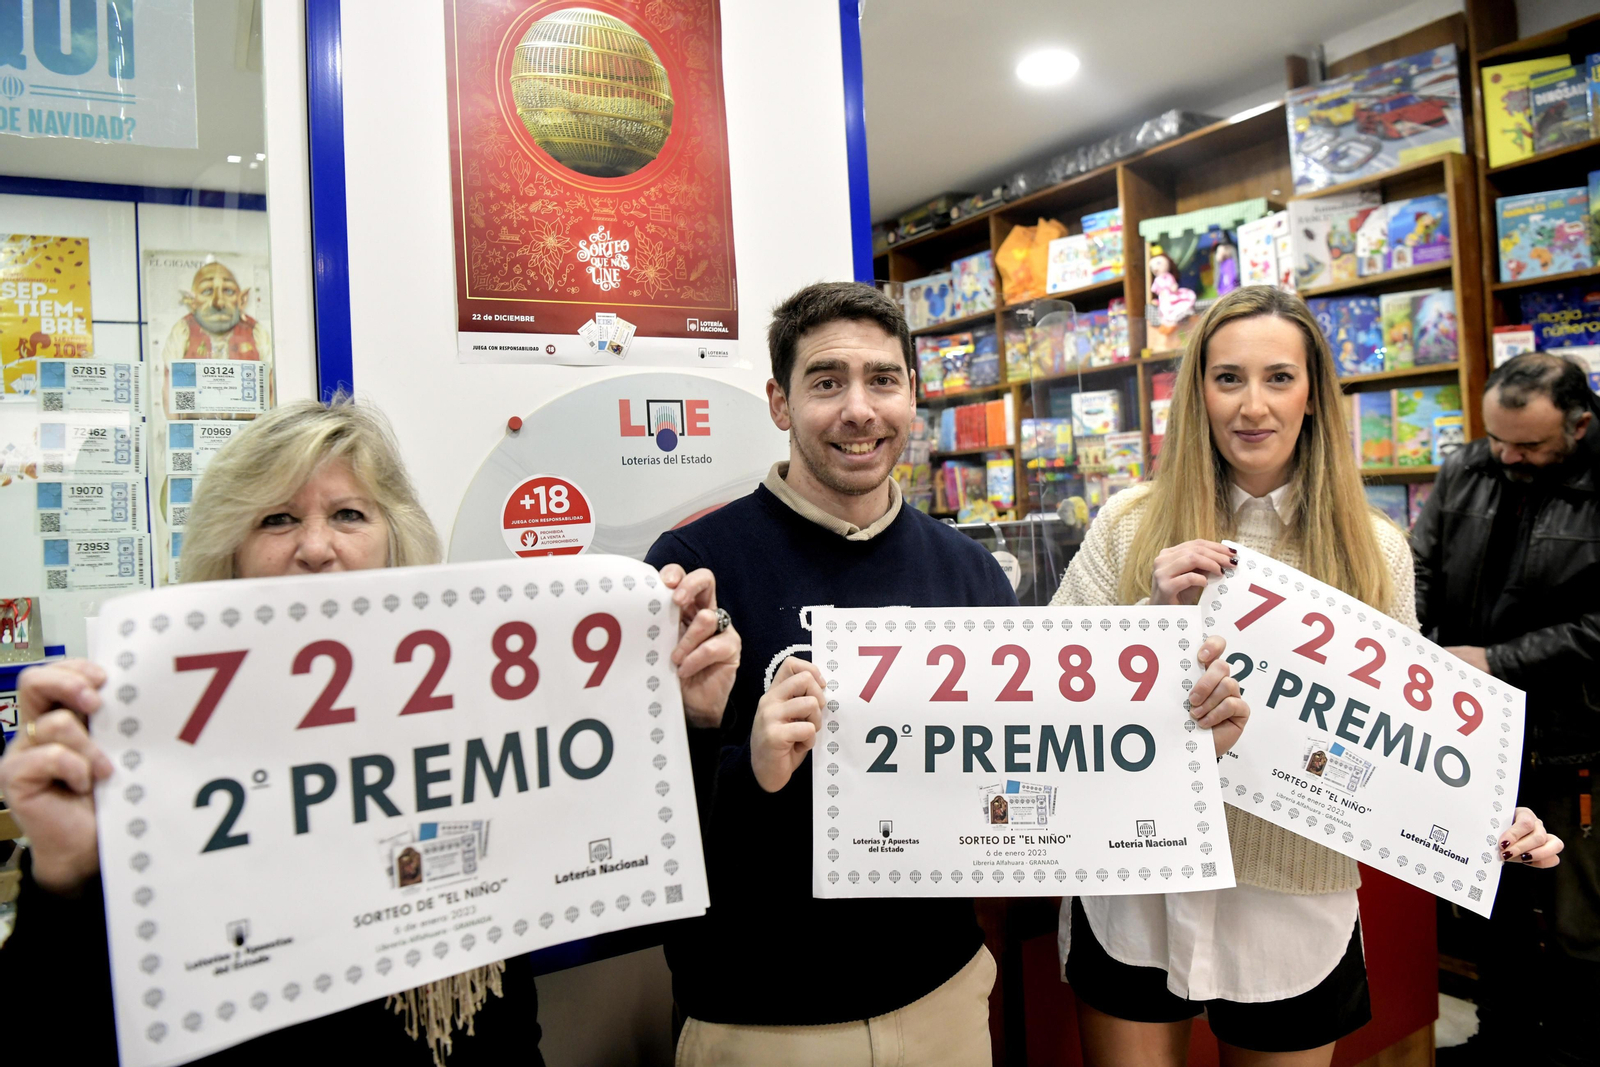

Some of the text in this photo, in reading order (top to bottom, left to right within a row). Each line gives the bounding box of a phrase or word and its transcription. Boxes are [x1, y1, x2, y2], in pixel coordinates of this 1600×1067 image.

[28, 108, 136, 141] NAVIDAD?
[588, 225, 613, 242] EL
[577, 239, 630, 262] SORTEO
[163, 258, 203, 270] GIGANT
[590, 253, 630, 270] QUE NOS
[585, 266, 621, 291] UNE
[1, 282, 59, 299] SEP-
[14, 300, 84, 317] TIEM-
[41, 317, 87, 335] BRE
[494, 314, 535, 322] DICIEMBRE
[72, 366, 106, 375] 67815
[203, 366, 235, 375] 03124
[73, 427, 107, 437] 72462
[200, 427, 232, 436] 70969
[621, 453, 713, 466] Loterías del Estado
[70, 486, 104, 495] 19070
[520, 484, 570, 515] +18
[540, 515, 584, 523] RESPONSABILIDAD
[76, 542, 110, 551] 73953
[541, 538, 579, 546] AUTOPROHIBIDOS
[1266, 668, 1471, 788] PREMIO
[924, 723, 1157, 773] PREMIO
[290, 717, 614, 835] PREMIO
[1271, 768, 1372, 814] SORTEO DE "EL NIÑO"
[1297, 792, 1306, 800] de
[1307, 797, 1326, 808] enero
[1327, 804, 1346, 816] 2023
[1325, 813, 1352, 828] GRANADA
[852, 837, 881, 845] Loterías
[888, 838, 920, 846] Apuestas
[959, 833, 1072, 845] SORTEO DE "EL NIÑO"
[1108, 837, 1188, 848] Lotería Nacional
[1400, 829, 1469, 865] Lotería Nacional
[993, 849, 1003, 857] de
[1027, 849, 1047, 857] 2023
[555, 855, 649, 884] Lotería Nacional
[353, 903, 412, 928] SORTEO
[416, 898, 434, 912] DE
[464, 878, 508, 899] NIÑO"
